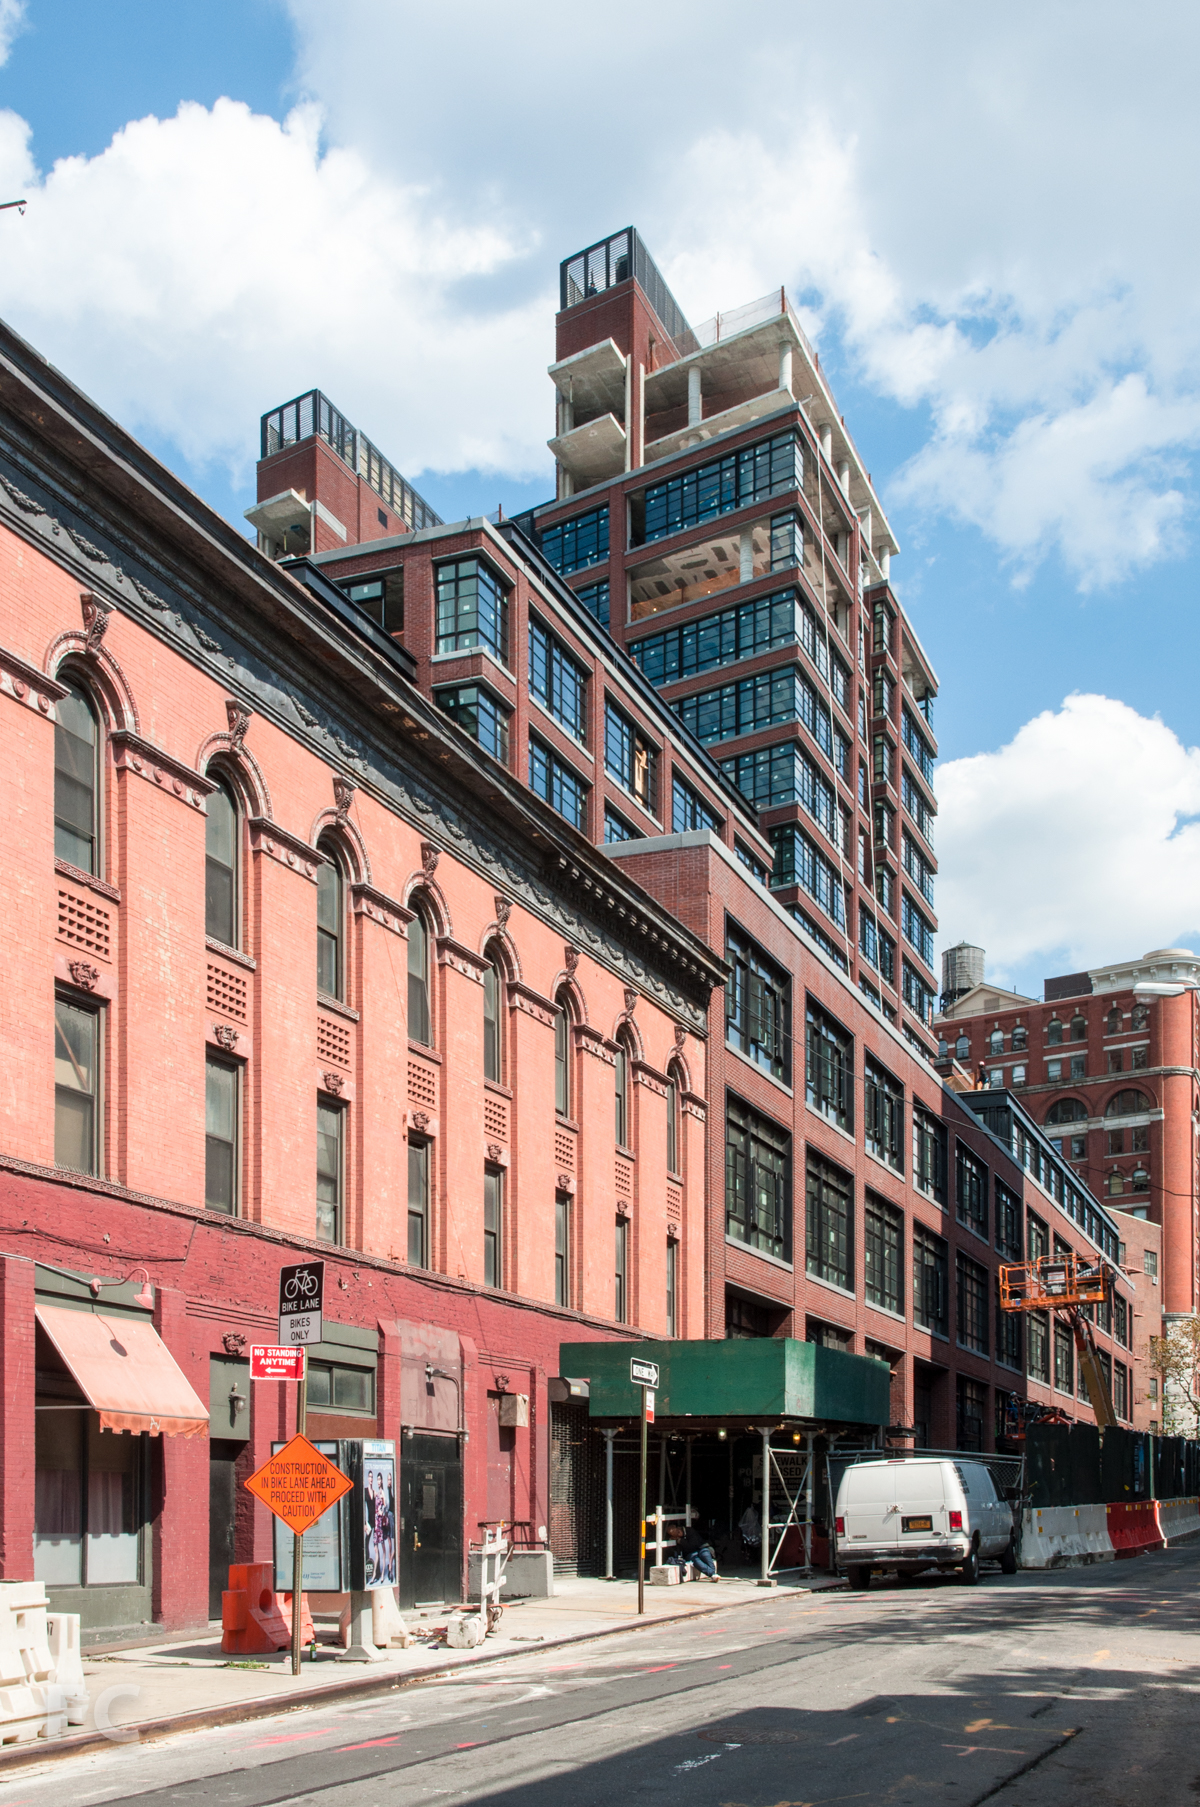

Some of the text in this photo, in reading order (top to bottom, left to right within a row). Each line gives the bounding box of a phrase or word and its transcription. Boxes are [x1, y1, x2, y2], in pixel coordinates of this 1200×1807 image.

[282, 1298, 320, 1312] BIKE LANE
[290, 1317, 311, 1329] BIKES
[290, 1330, 310, 1341] ONLY
[267, 1349, 302, 1357] STANDING
[259, 1358, 296, 1366] ANYTIME
[635, 1366, 645, 1377] ONE
[371, 1443, 386, 1453] TITAN
[269, 1463, 328, 1475] CONSTRUCTION
[261, 1477, 336, 1489] IN BIKE LANE AHEAD
[270, 1491, 327, 1503] PROCEED WITH
[282, 1505, 315, 1517] CAUTION
